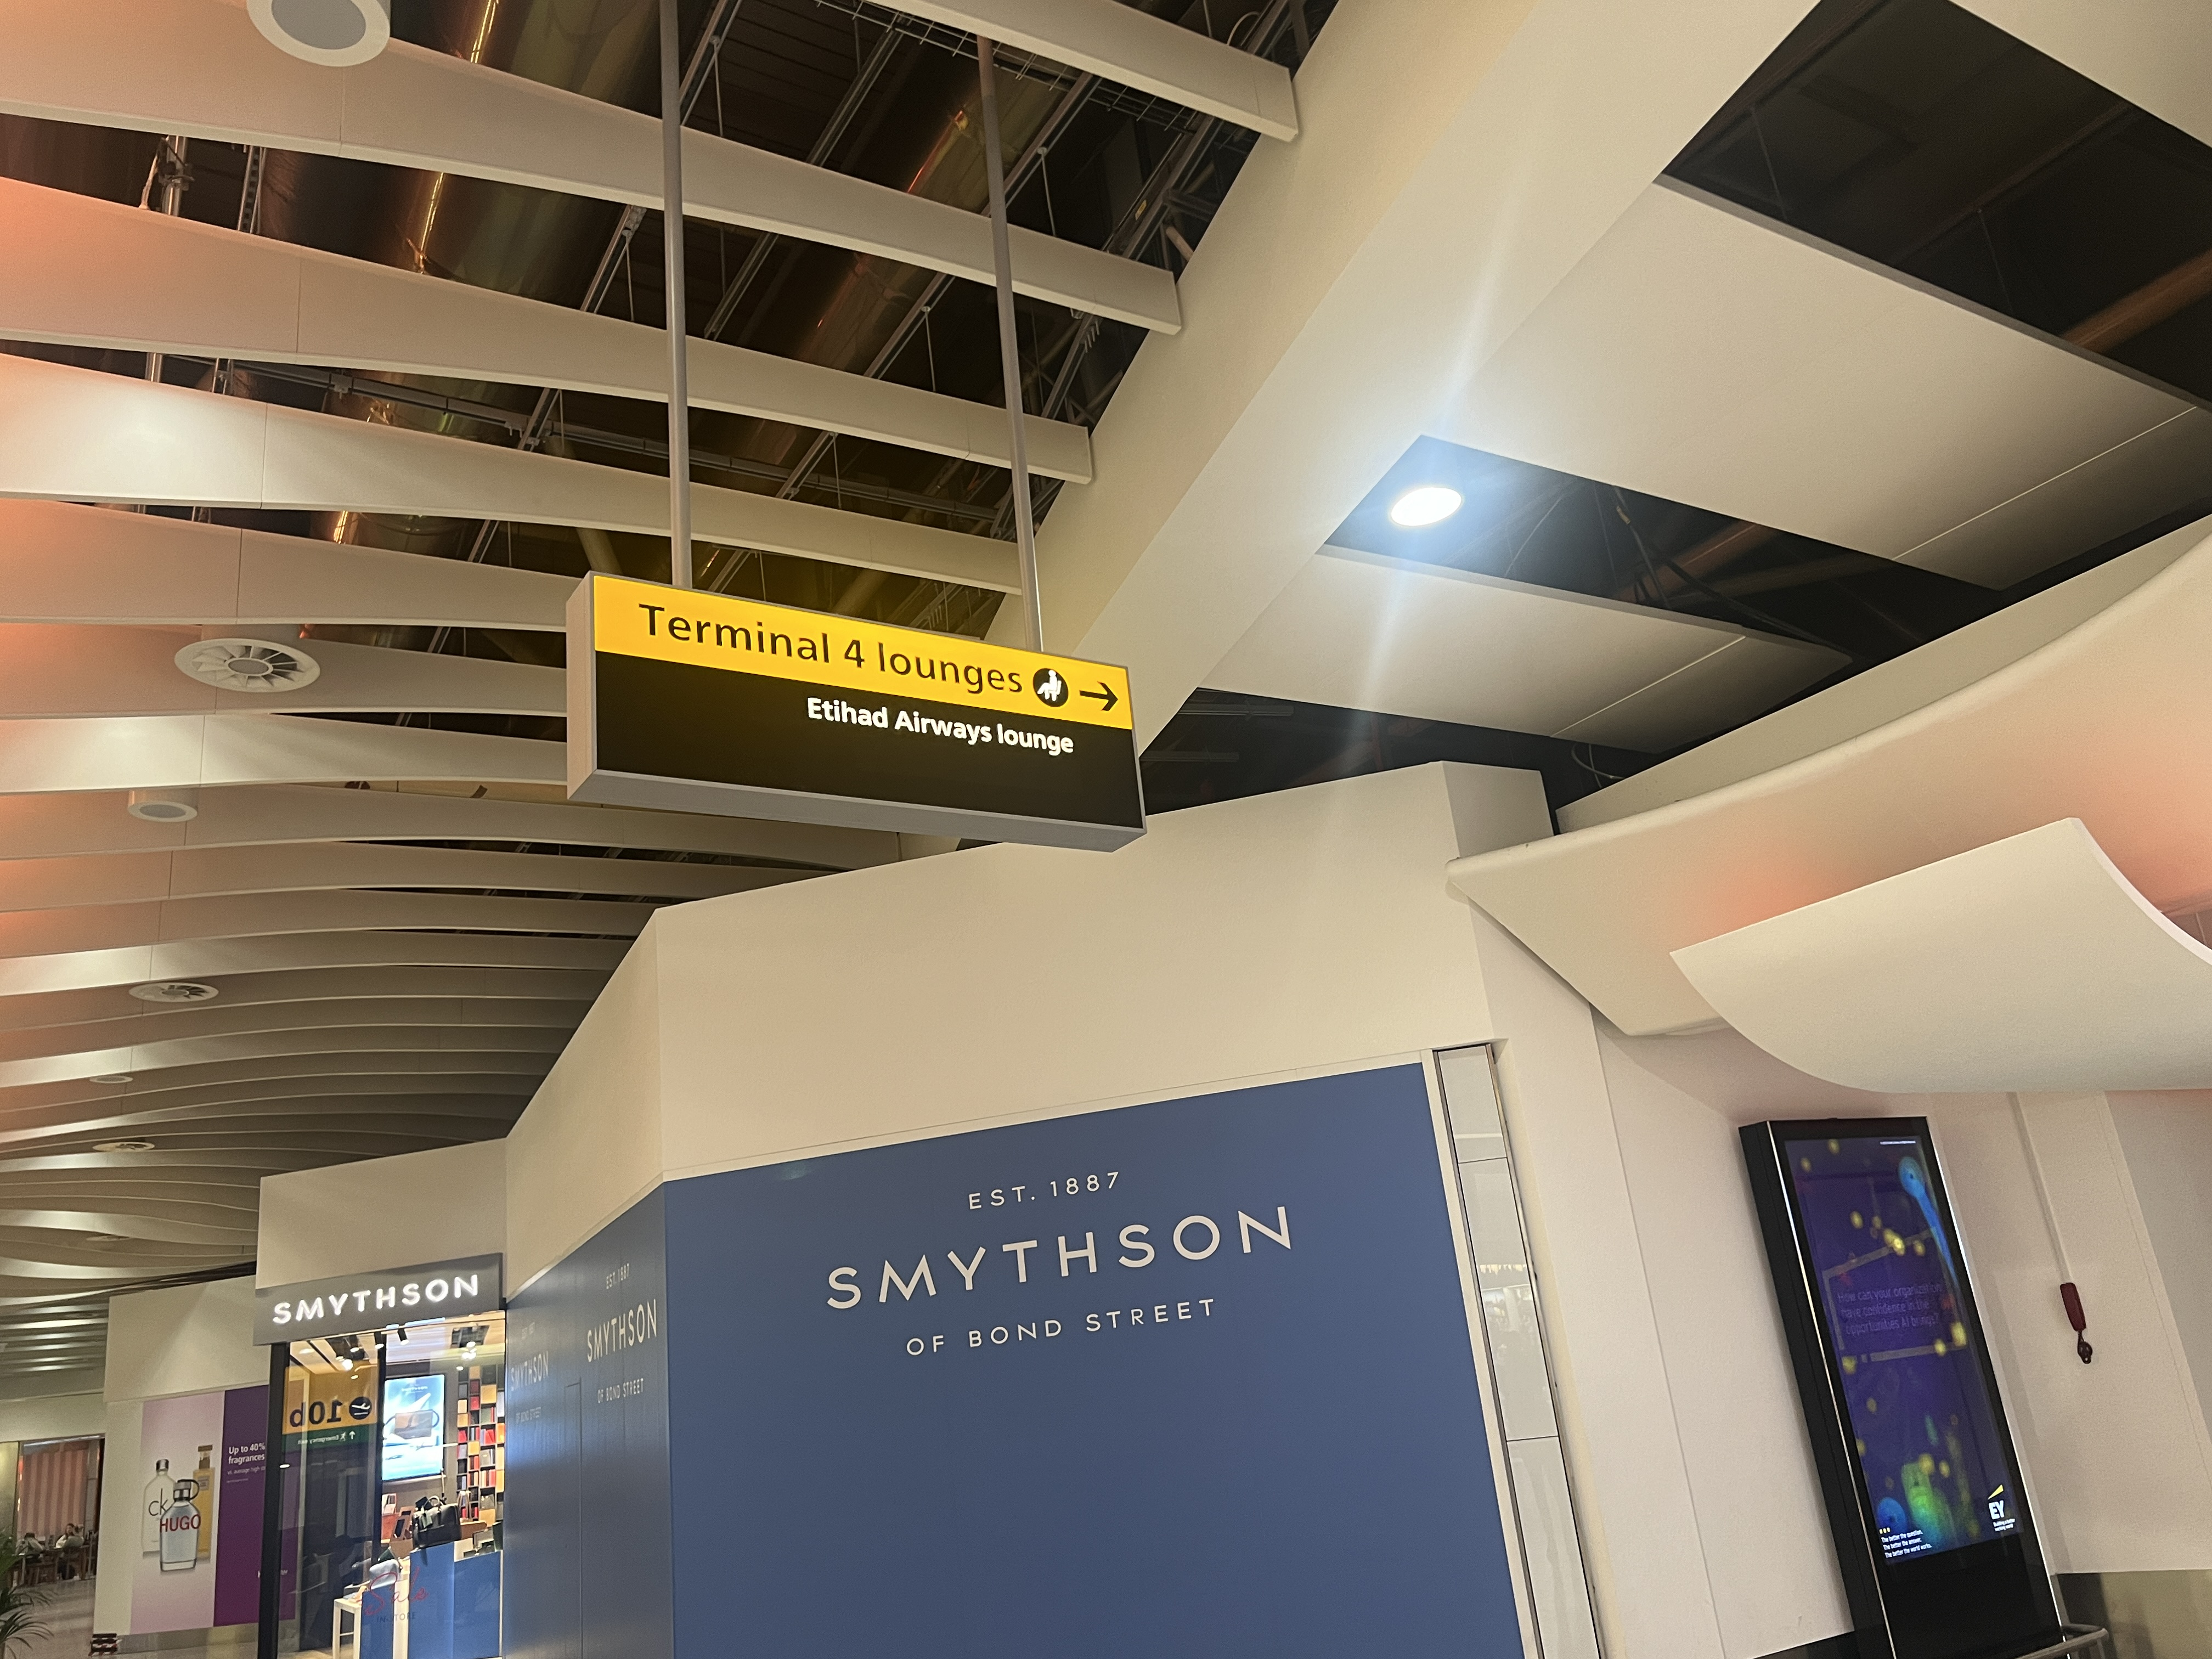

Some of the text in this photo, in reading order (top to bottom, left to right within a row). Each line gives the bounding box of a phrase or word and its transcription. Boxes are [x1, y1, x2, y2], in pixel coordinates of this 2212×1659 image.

[639, 603, 1022, 694] Terminal 4 lounges
[808, 697, 1074, 756] Etihad Airways lounge
[968, 1171, 1120, 1210] EST. 1887
[827, 1206, 1291, 1310] SMYTHSON
[273, 1274, 478, 1324] SMYTHSON
[587, 1299, 657, 1363] SMYTHSON
[906, 1299, 1214, 1356] OF BOND STREET
[597, 1378, 644, 1403] OF BOND STREET
[228, 1454, 265, 1465] fragrances
[229, 1446, 239, 1455] Up
[250, 1442, 266, 1452] 40%
[149, 1488, 168, 1516] ck
[1988, 1500, 2005, 1520] EY
[160, 1514, 201, 1533] HUGO
